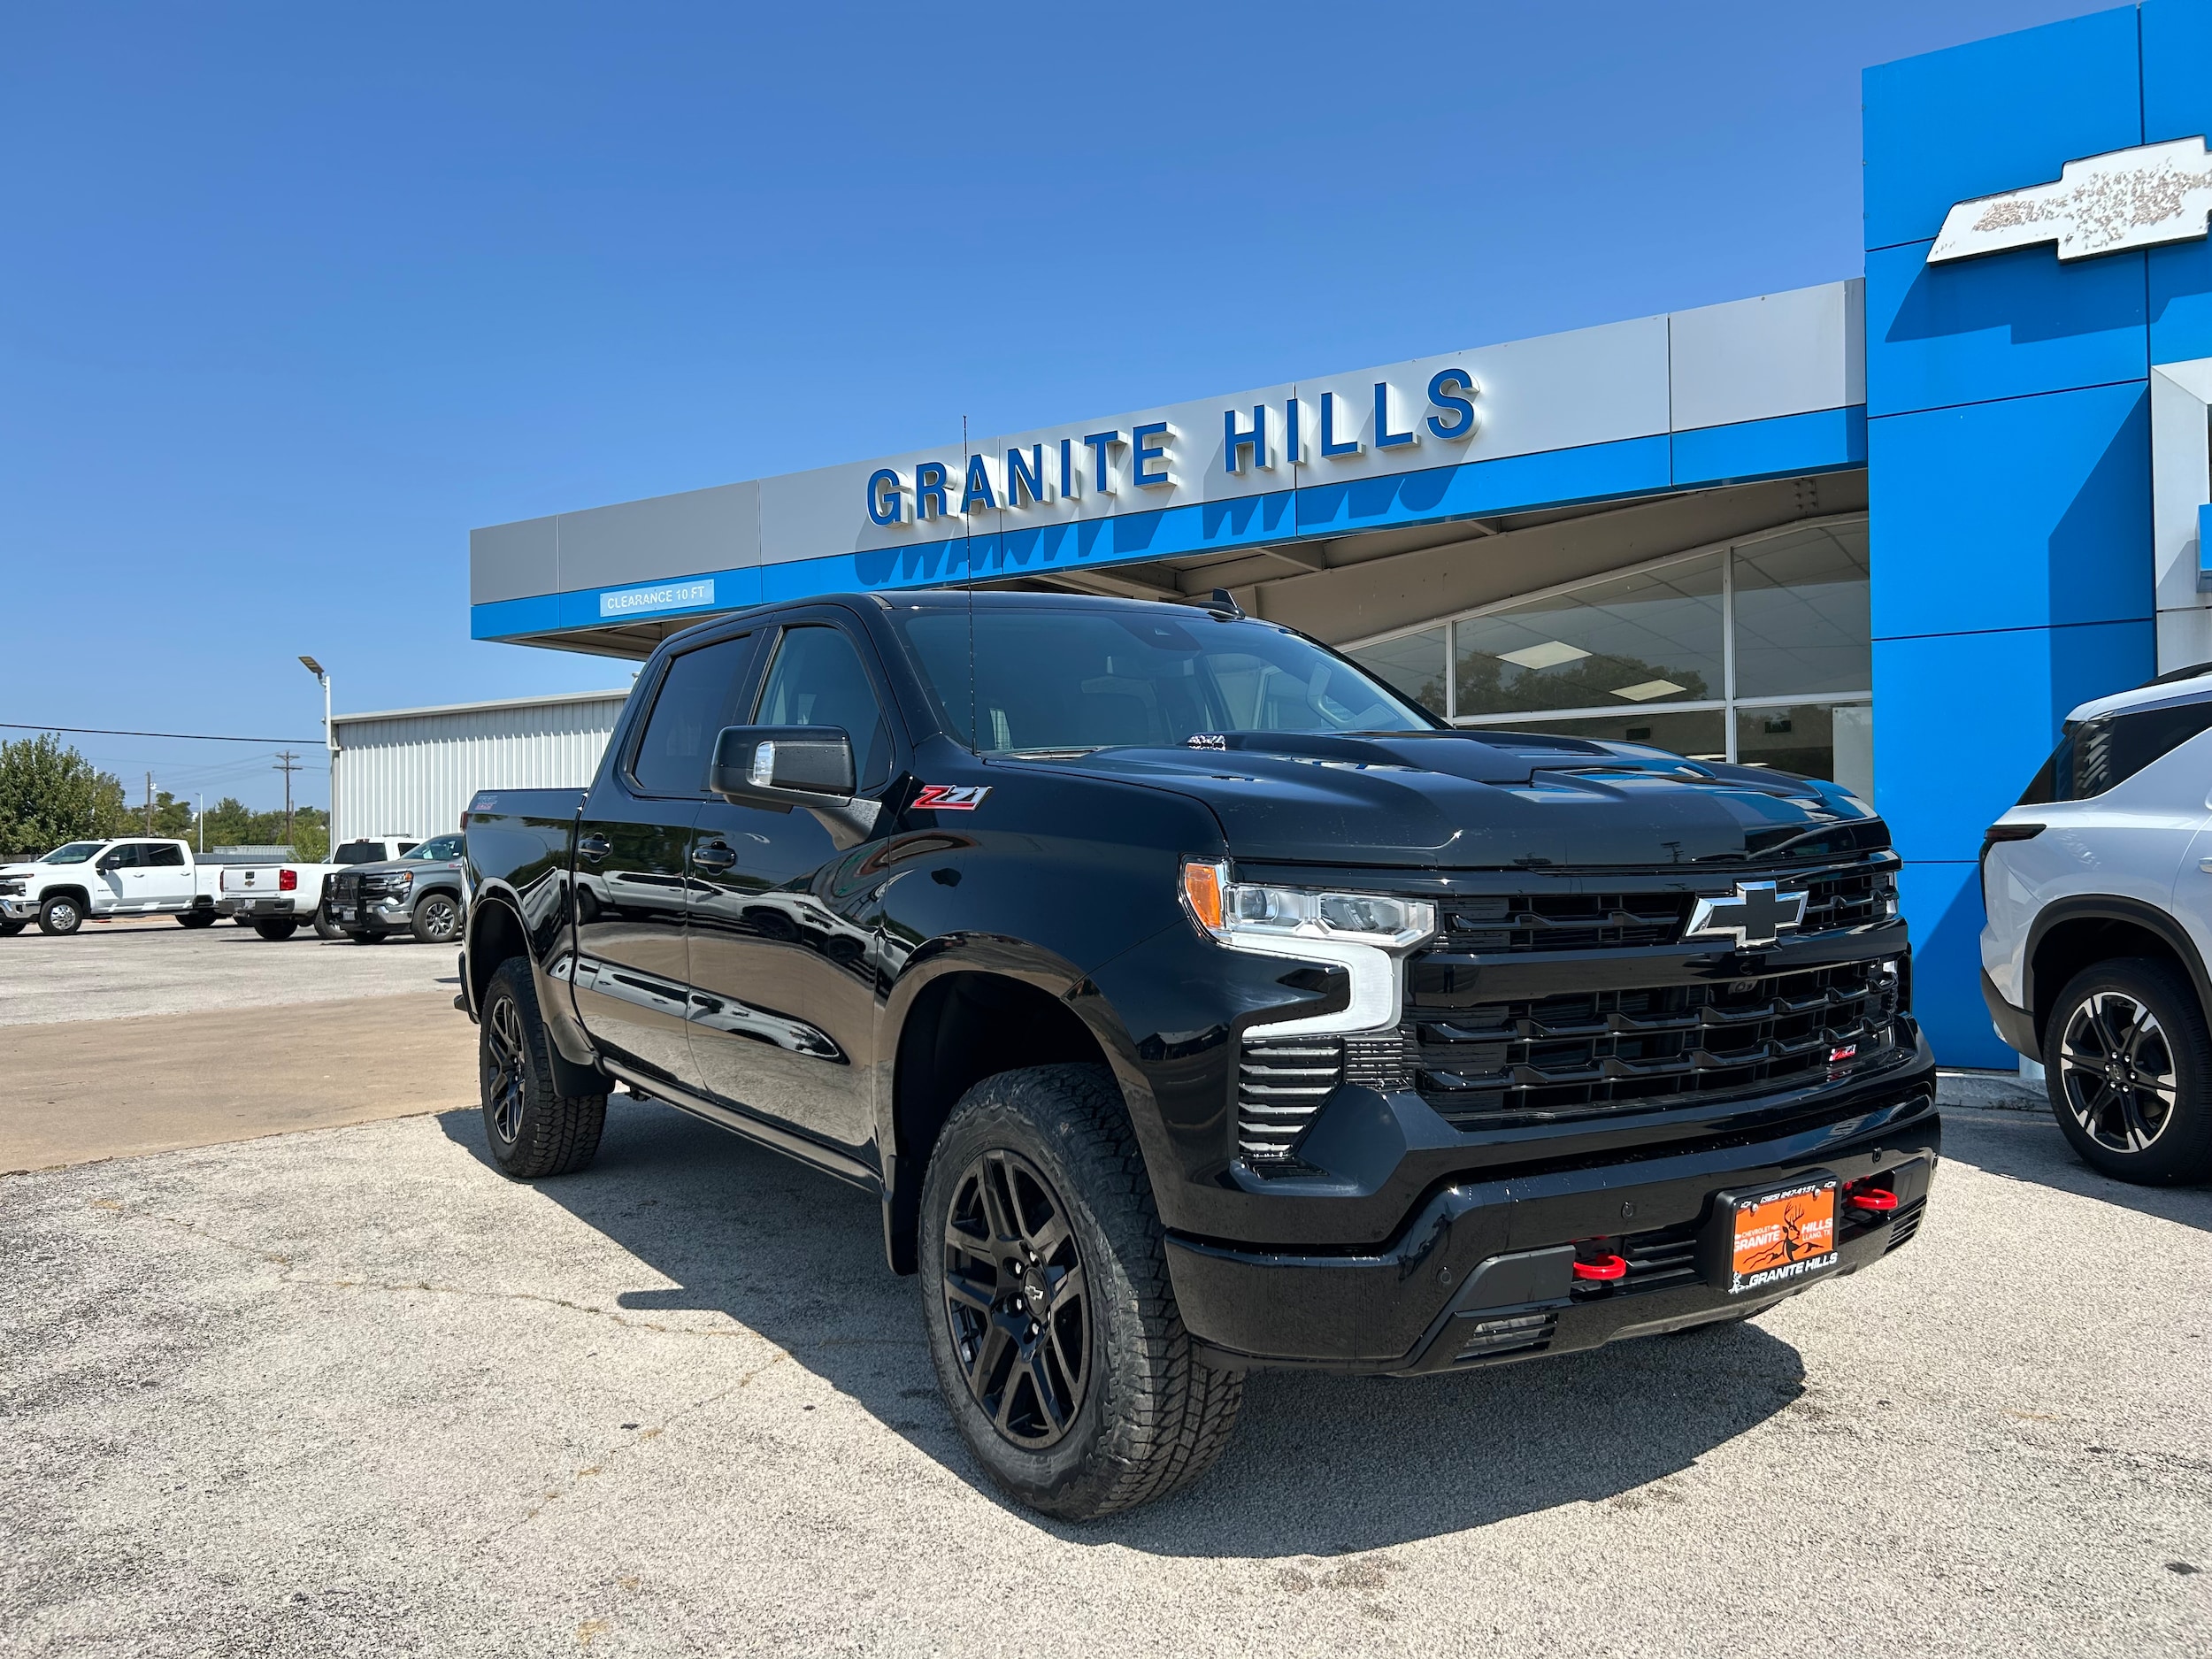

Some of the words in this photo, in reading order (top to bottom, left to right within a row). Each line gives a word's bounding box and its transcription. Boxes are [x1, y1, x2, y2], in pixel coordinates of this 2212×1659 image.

[866, 420, 1172, 528] GRANITE
[1224, 368, 1479, 474] HILLS
[607, 589, 672, 609] CLEARANCE
[676, 588, 688, 601] 10
[691, 586, 705, 599] FT
[910, 784, 993, 810] Z71
[1741, 1225, 1771, 1238] CHEVROLET
[1801, 1217, 1832, 1233] HILLS
[1749, 1262, 1804, 1286] GRANITE
[1805, 1252, 1839, 1271] HILLS
